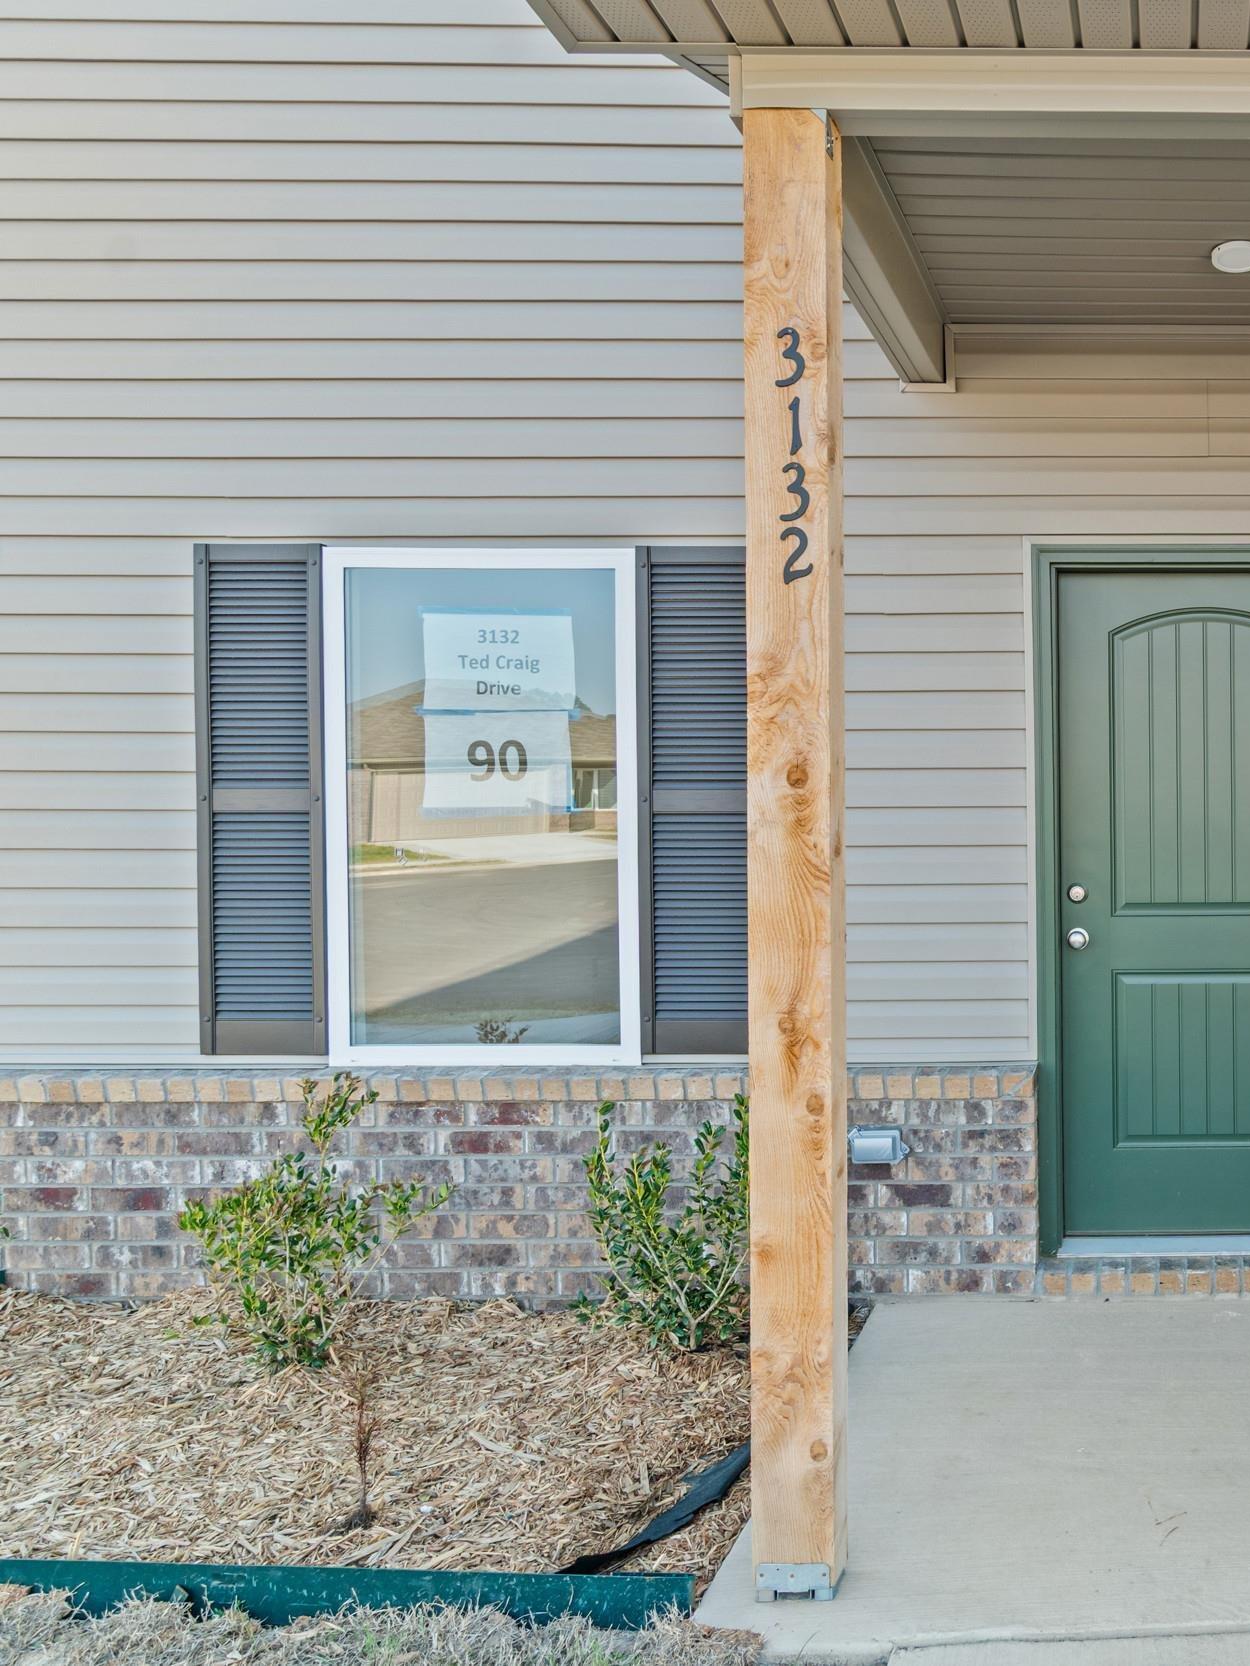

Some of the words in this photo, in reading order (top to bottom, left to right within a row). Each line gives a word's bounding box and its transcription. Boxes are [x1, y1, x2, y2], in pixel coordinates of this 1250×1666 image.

[774, 326, 814, 585] 3132
[477, 629, 520, 645] 3132
[457, 655, 489, 670] Ted
[496, 655, 540, 673] Craig
[476, 681, 521, 695] Drive
[466, 739, 528, 782] 90
